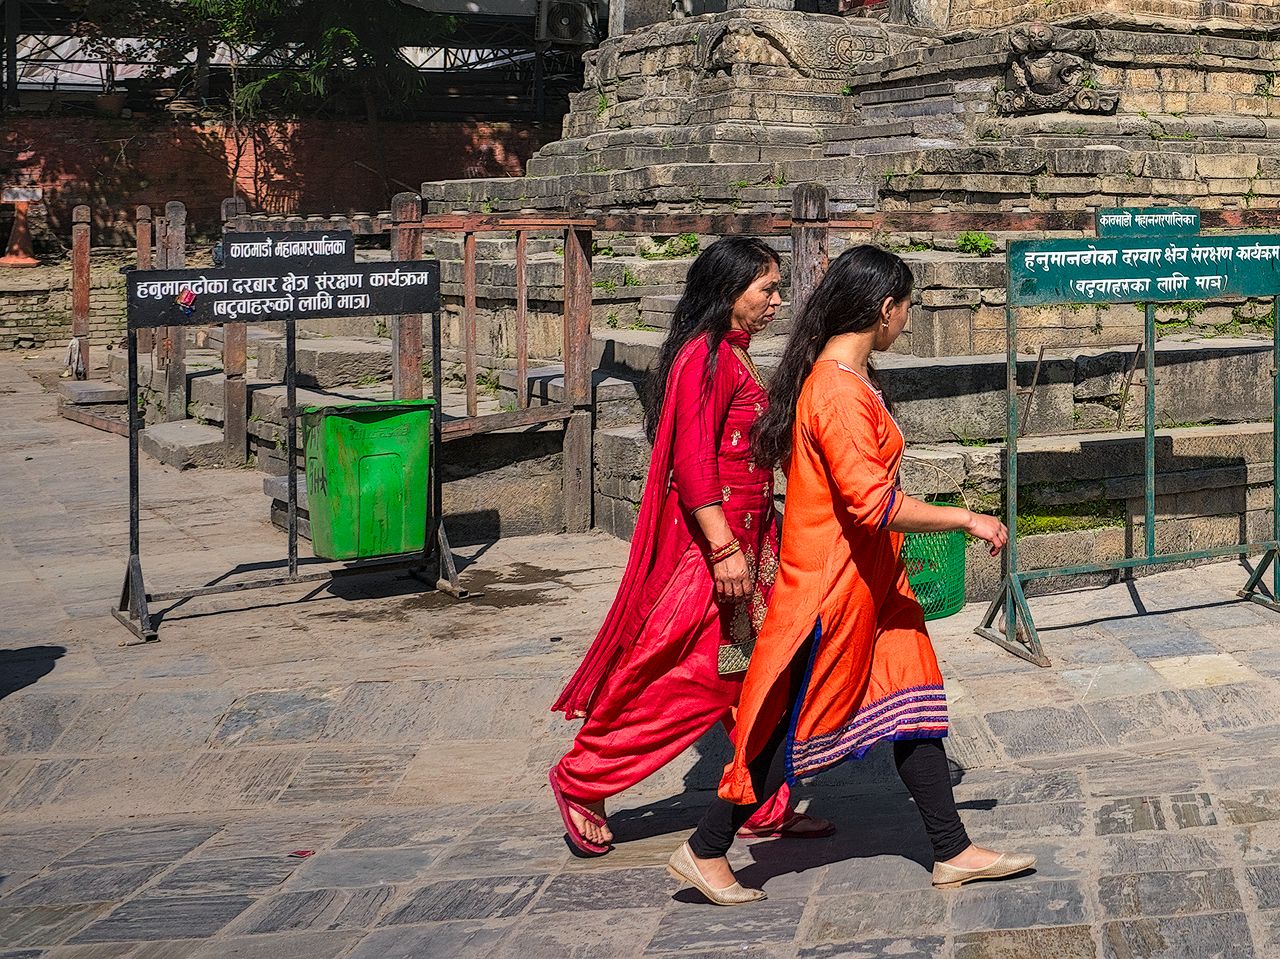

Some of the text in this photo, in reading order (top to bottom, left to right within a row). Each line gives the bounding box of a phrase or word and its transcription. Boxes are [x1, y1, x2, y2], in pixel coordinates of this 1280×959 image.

[274, 234, 346, 258] महानगरपालिका
[1024, 244, 1119, 272] हनुमानढोका
[1190, 243, 1234, 266] संरक्षण
[231, 277, 279, 294] दरबार
[281, 272, 310, 293] क्षेत्र
[314, 271, 364, 293] संरक्षण
[369, 268, 430, 287] कार्यक्रम
[1156, 271, 1190, 294] लागि
[298, 291, 334, 312] लागि
[337, 293, 370, 310] मात्र)
